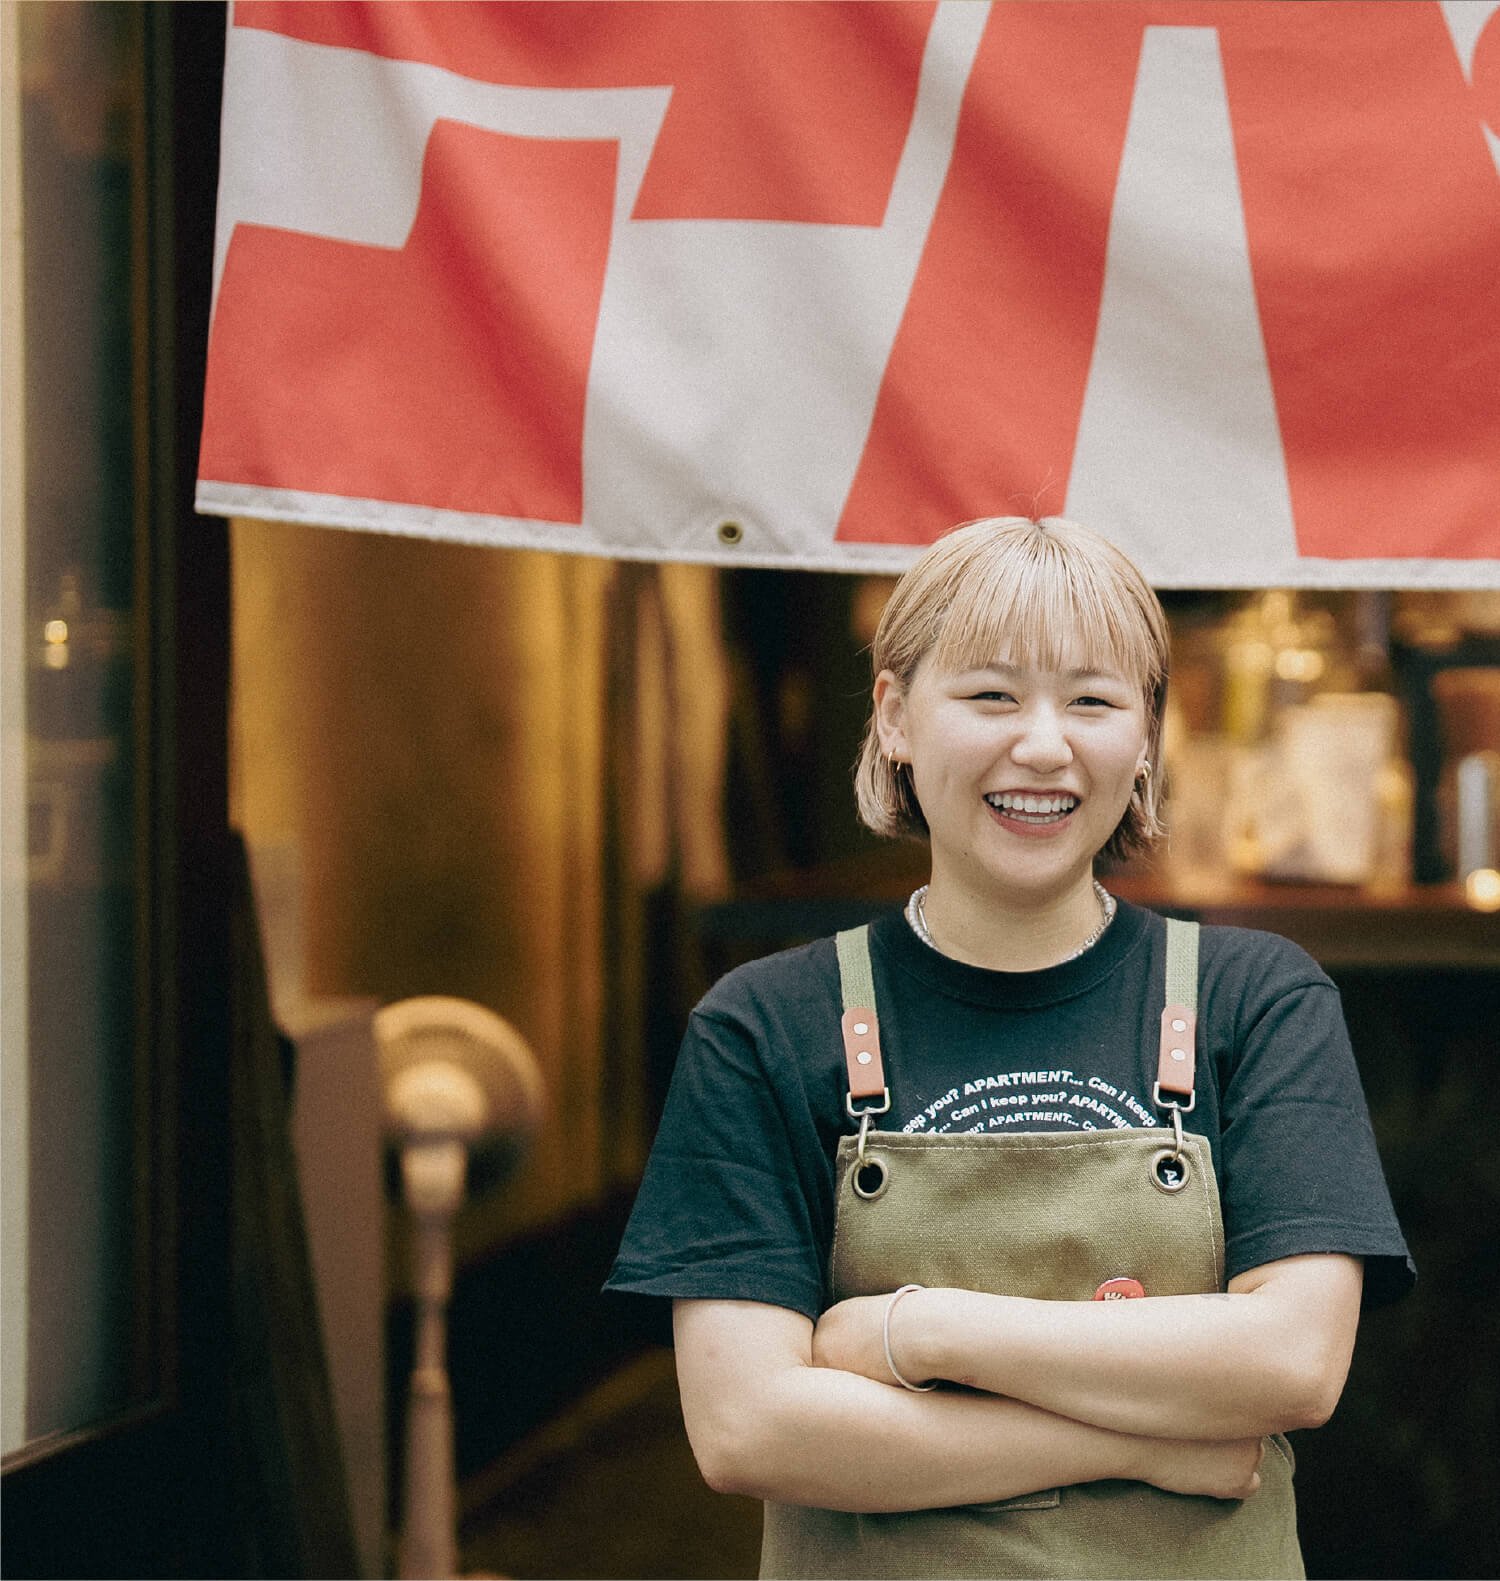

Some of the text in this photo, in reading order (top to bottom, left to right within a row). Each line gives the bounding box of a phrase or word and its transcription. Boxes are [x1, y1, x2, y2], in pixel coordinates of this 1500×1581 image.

[902, 1114, 927, 1133] eep
[924, 1088, 960, 1120] you?
[964, 1070, 1084, 1096] APARTMENT...
[1088, 1076, 1118, 1097] Can
[1125, 1096, 1157, 1127] keep
[950, 1104, 980, 1121] Can
[990, 1095, 1028, 1108] keep
[1031, 1091, 1068, 1105] you?
[988, 1112, 1079, 1128] APARTMENT...
